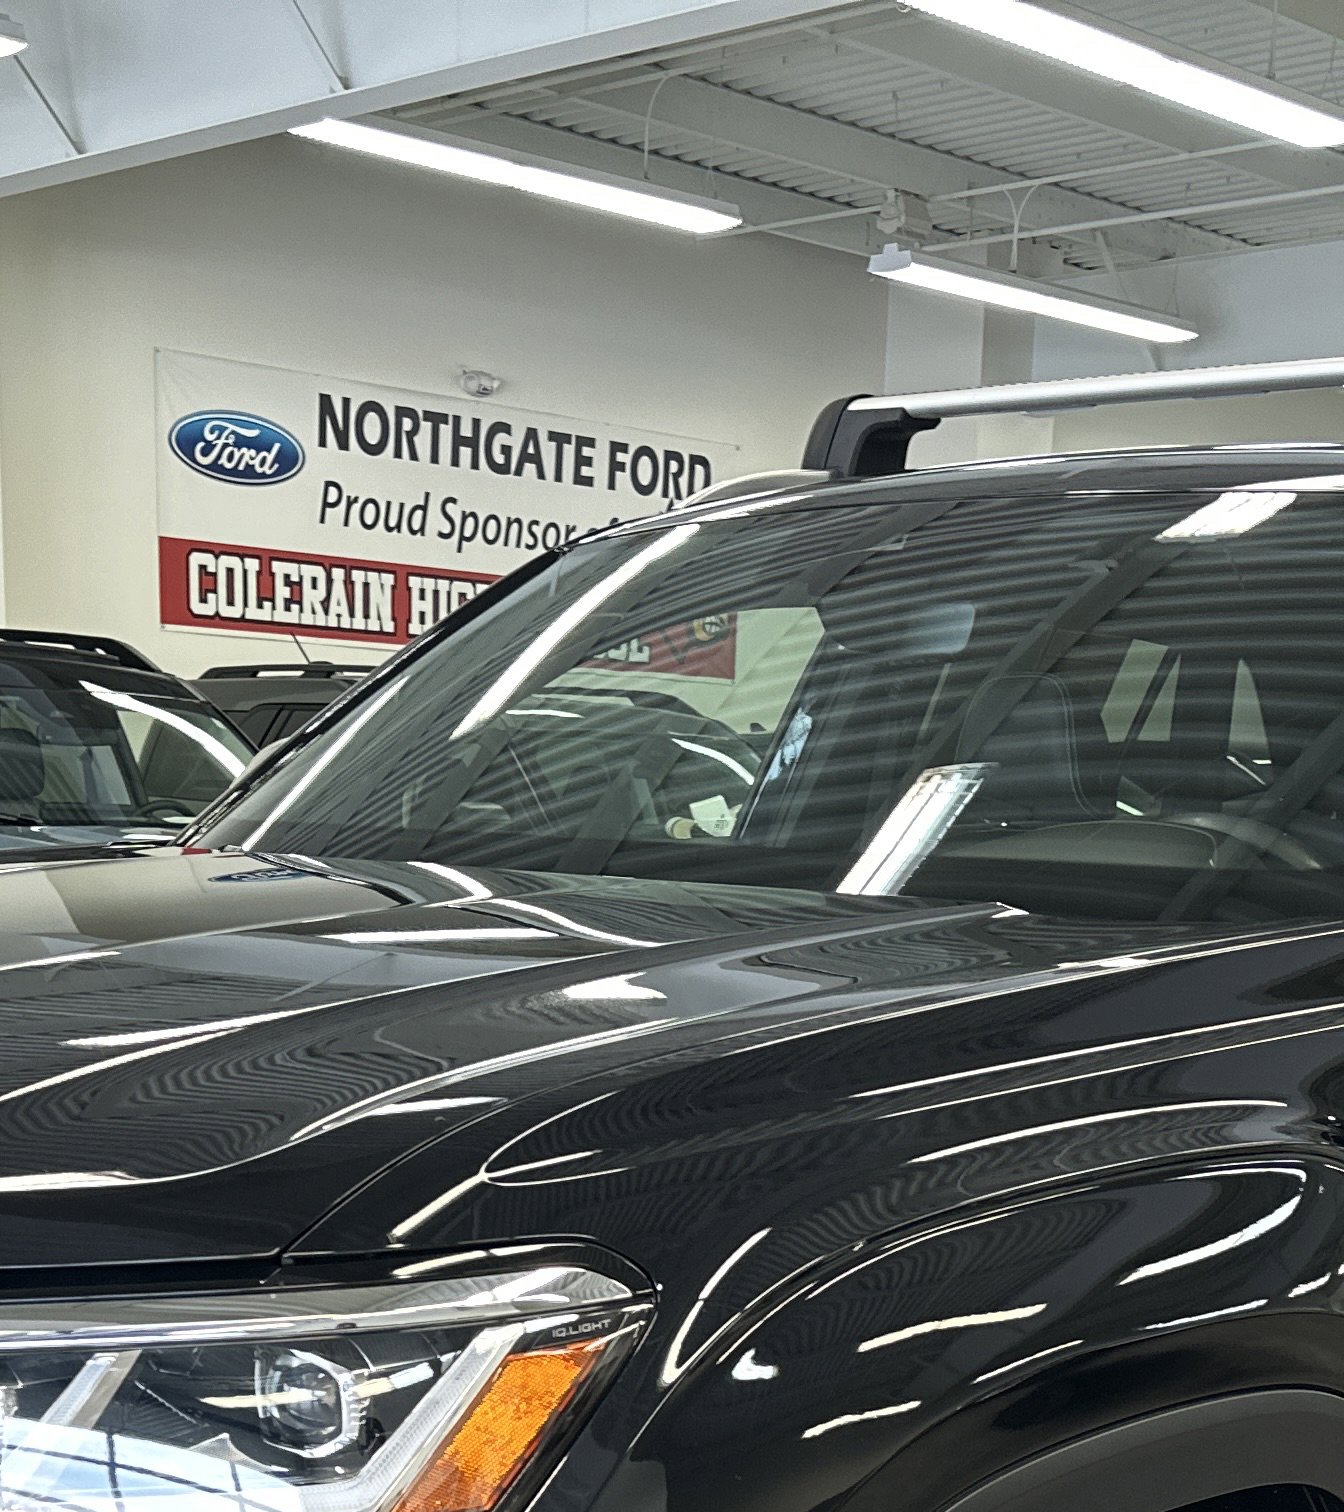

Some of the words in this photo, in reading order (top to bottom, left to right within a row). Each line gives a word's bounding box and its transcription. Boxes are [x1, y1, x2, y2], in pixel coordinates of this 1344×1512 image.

[191, 418, 284, 477] Ford
[318, 393, 596, 487] NORTHGATE
[607, 440, 712, 501] FORD
[319, 480, 431, 537] Proud
[437, 496, 577, 553] Sponsor
[187, 549, 397, 635] COLERAIN
[408, 575, 490, 635] HI
